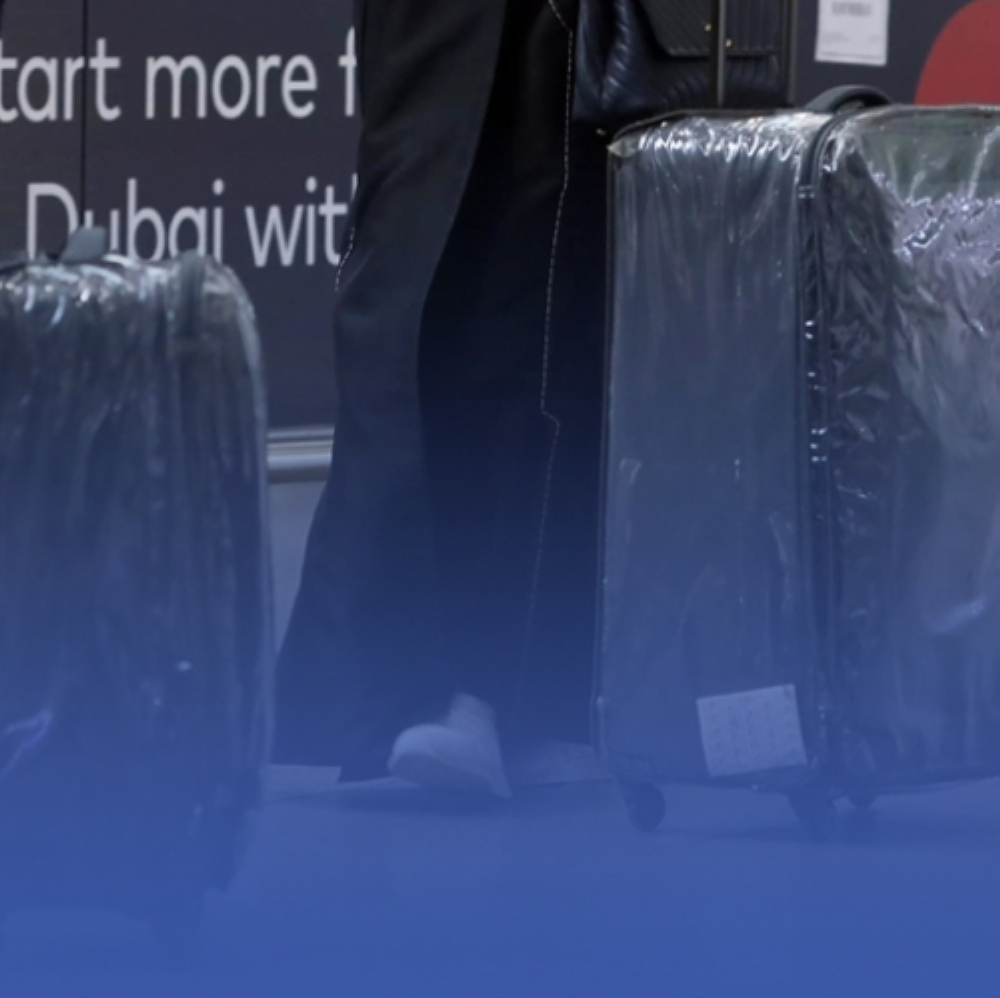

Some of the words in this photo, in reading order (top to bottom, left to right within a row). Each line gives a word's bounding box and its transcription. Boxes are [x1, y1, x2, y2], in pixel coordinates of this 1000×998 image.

[145, 54, 318, 120] more
[27, 177, 224, 265] Dubai
[244, 173, 357, 268] wit
